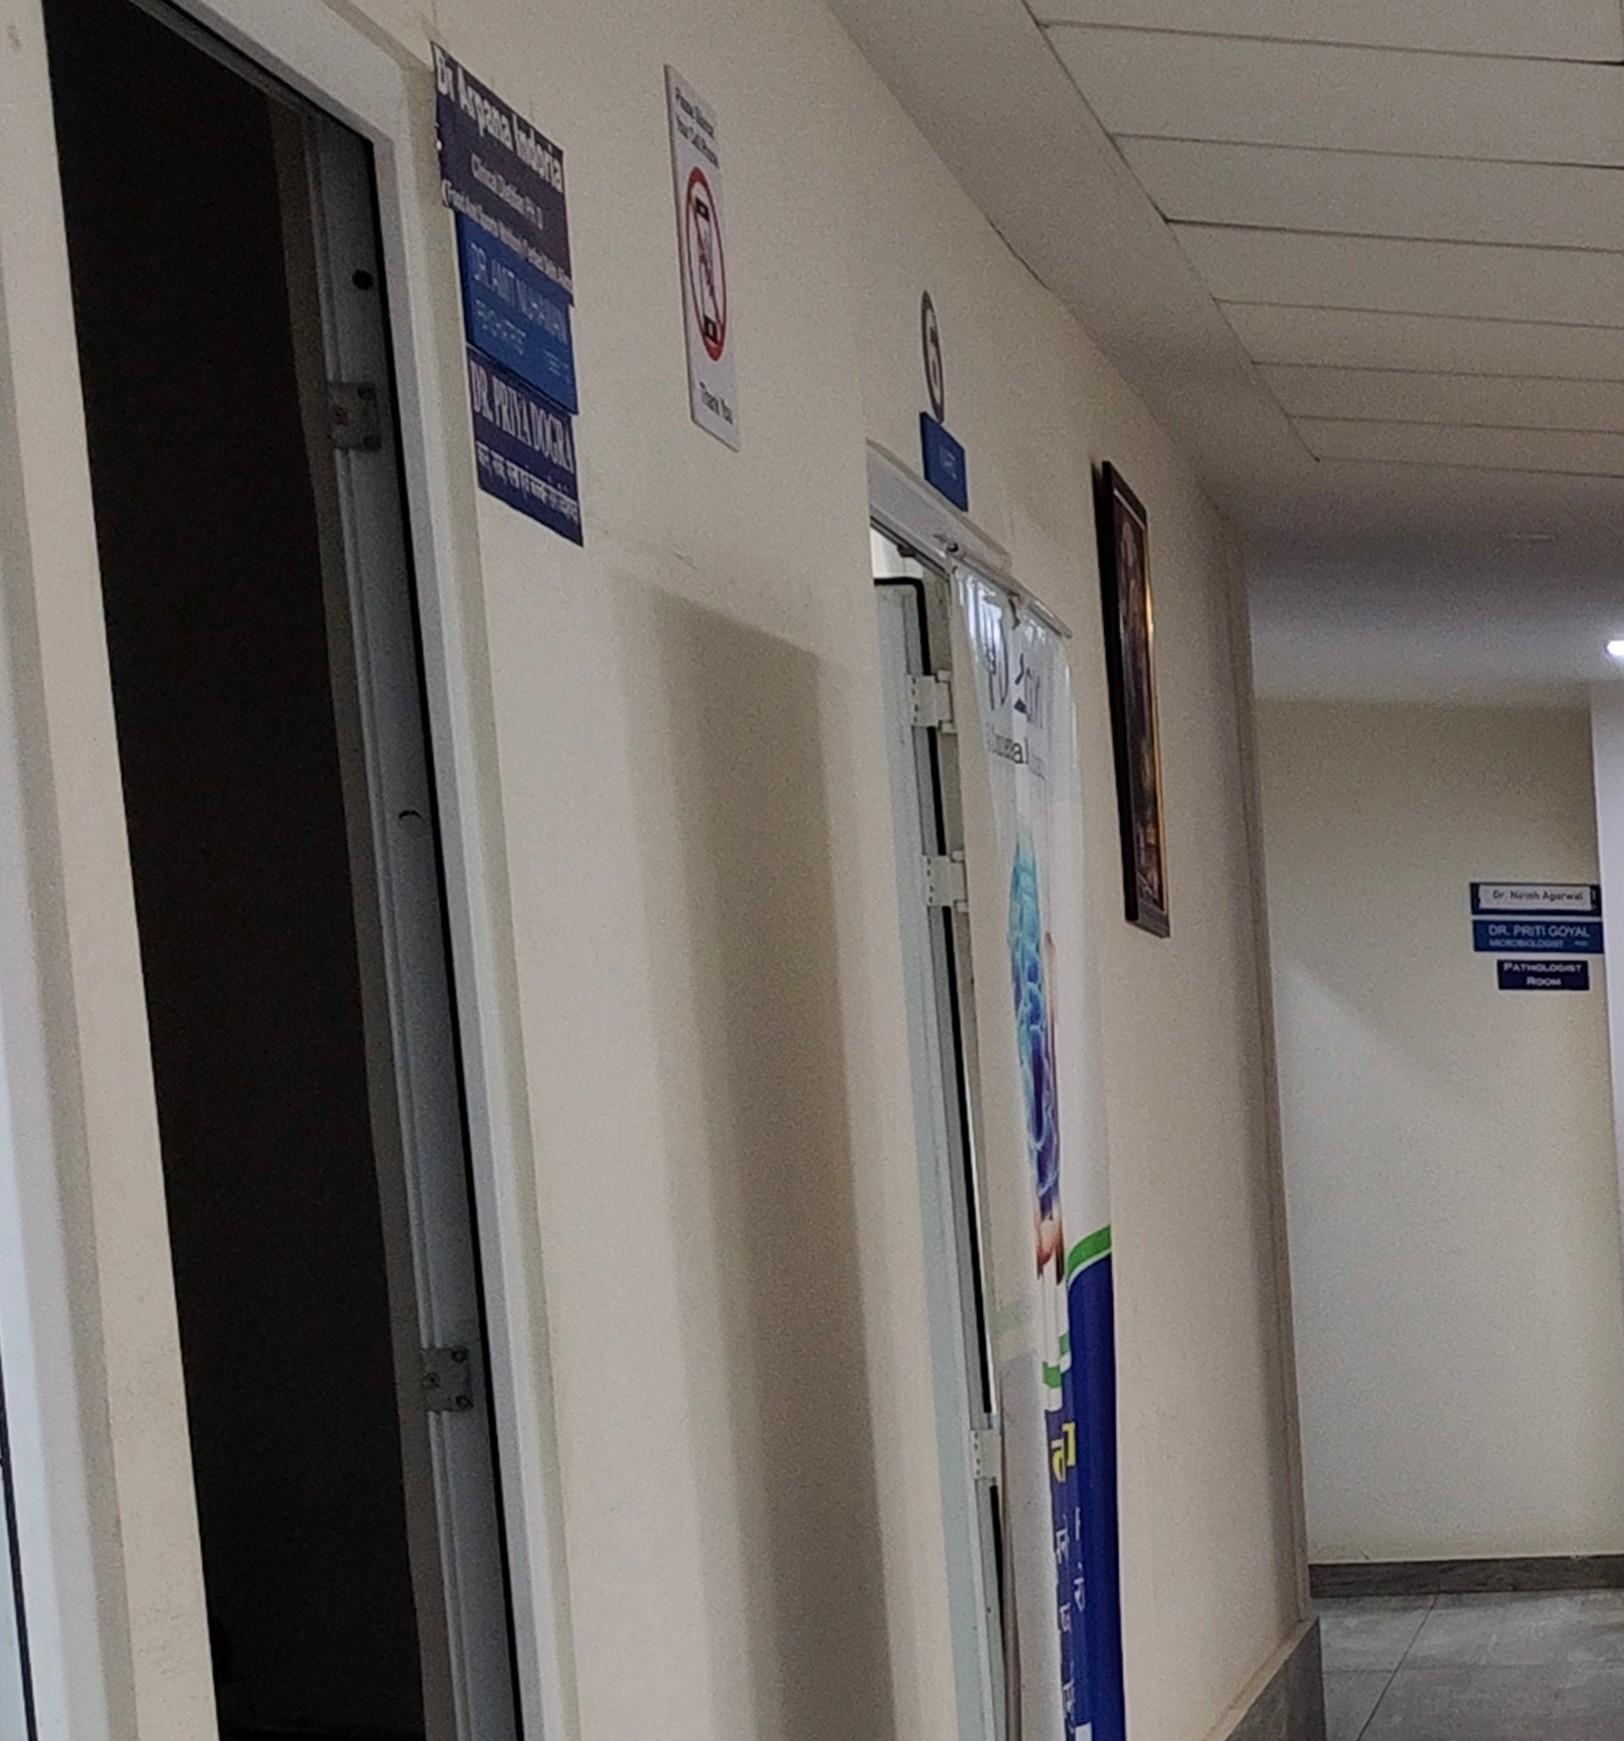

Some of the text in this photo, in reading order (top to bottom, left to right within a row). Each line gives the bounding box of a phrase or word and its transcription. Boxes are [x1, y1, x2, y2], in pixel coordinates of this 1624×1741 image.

[1488, 924, 1591, 937] DR. PRITI GOYAL
